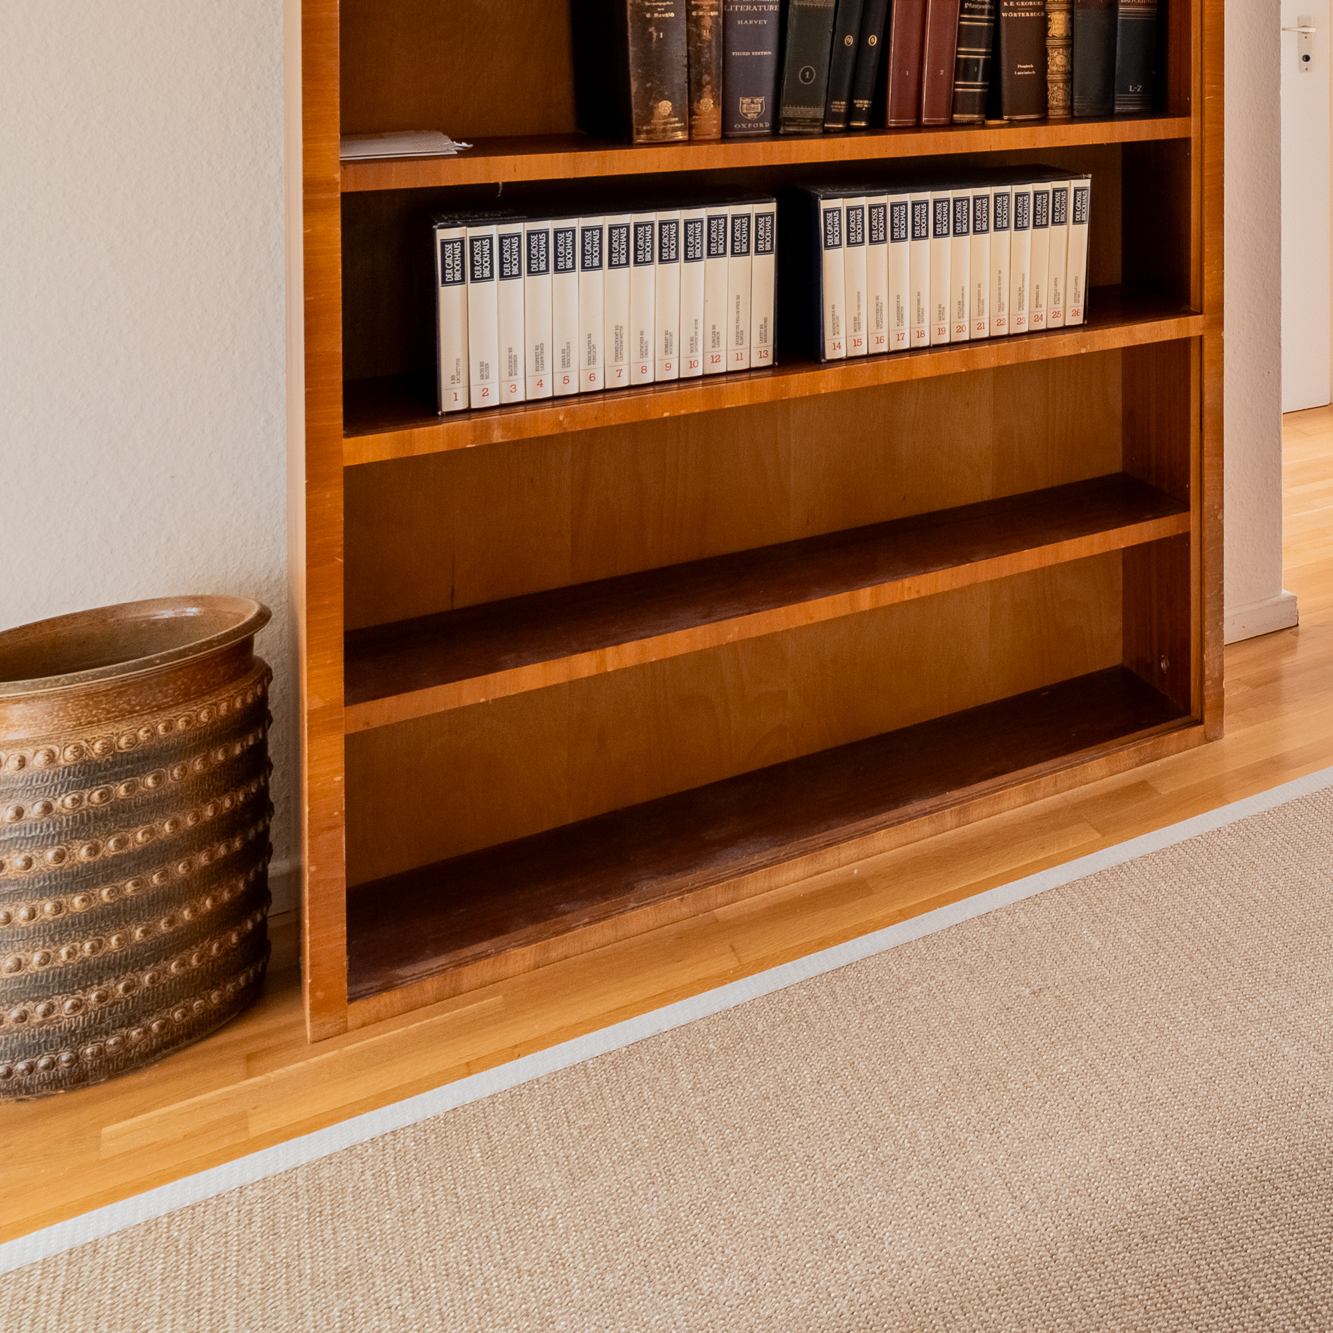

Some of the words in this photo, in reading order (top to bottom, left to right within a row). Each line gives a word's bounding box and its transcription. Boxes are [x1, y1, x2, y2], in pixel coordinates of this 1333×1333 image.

[474, 240, 482, 265] GROSSE
[503, 238, 511, 263] GROSSE
[445, 243, 453, 268] GROSSE
[474, 265, 482, 278] DER
[503, 263, 511, 275] DER
[445, 268, 453, 281] DER
[956, 325, 966, 333] 20
[876, 336, 884, 344] 16
[897, 333, 905, 341] 17
[833, 342, 841, 350] 14
[854, 338, 862, 347] 15
[711, 355, 720, 363] 12
[736, 353, 743, 361] 11
[665, 363, 671, 371] 9
[689, 360, 699, 369] 10
[617, 369, 622, 377] 7
[641, 366, 647, 374] 8
[563, 376, 570, 384] 5
[589, 373, 595, 382] 6
[536, 379, 543, 388] 4
[482, 388, 489, 397] 2
[510, 384, 517, 393] 3
[454, 392, 458, 401] 1
